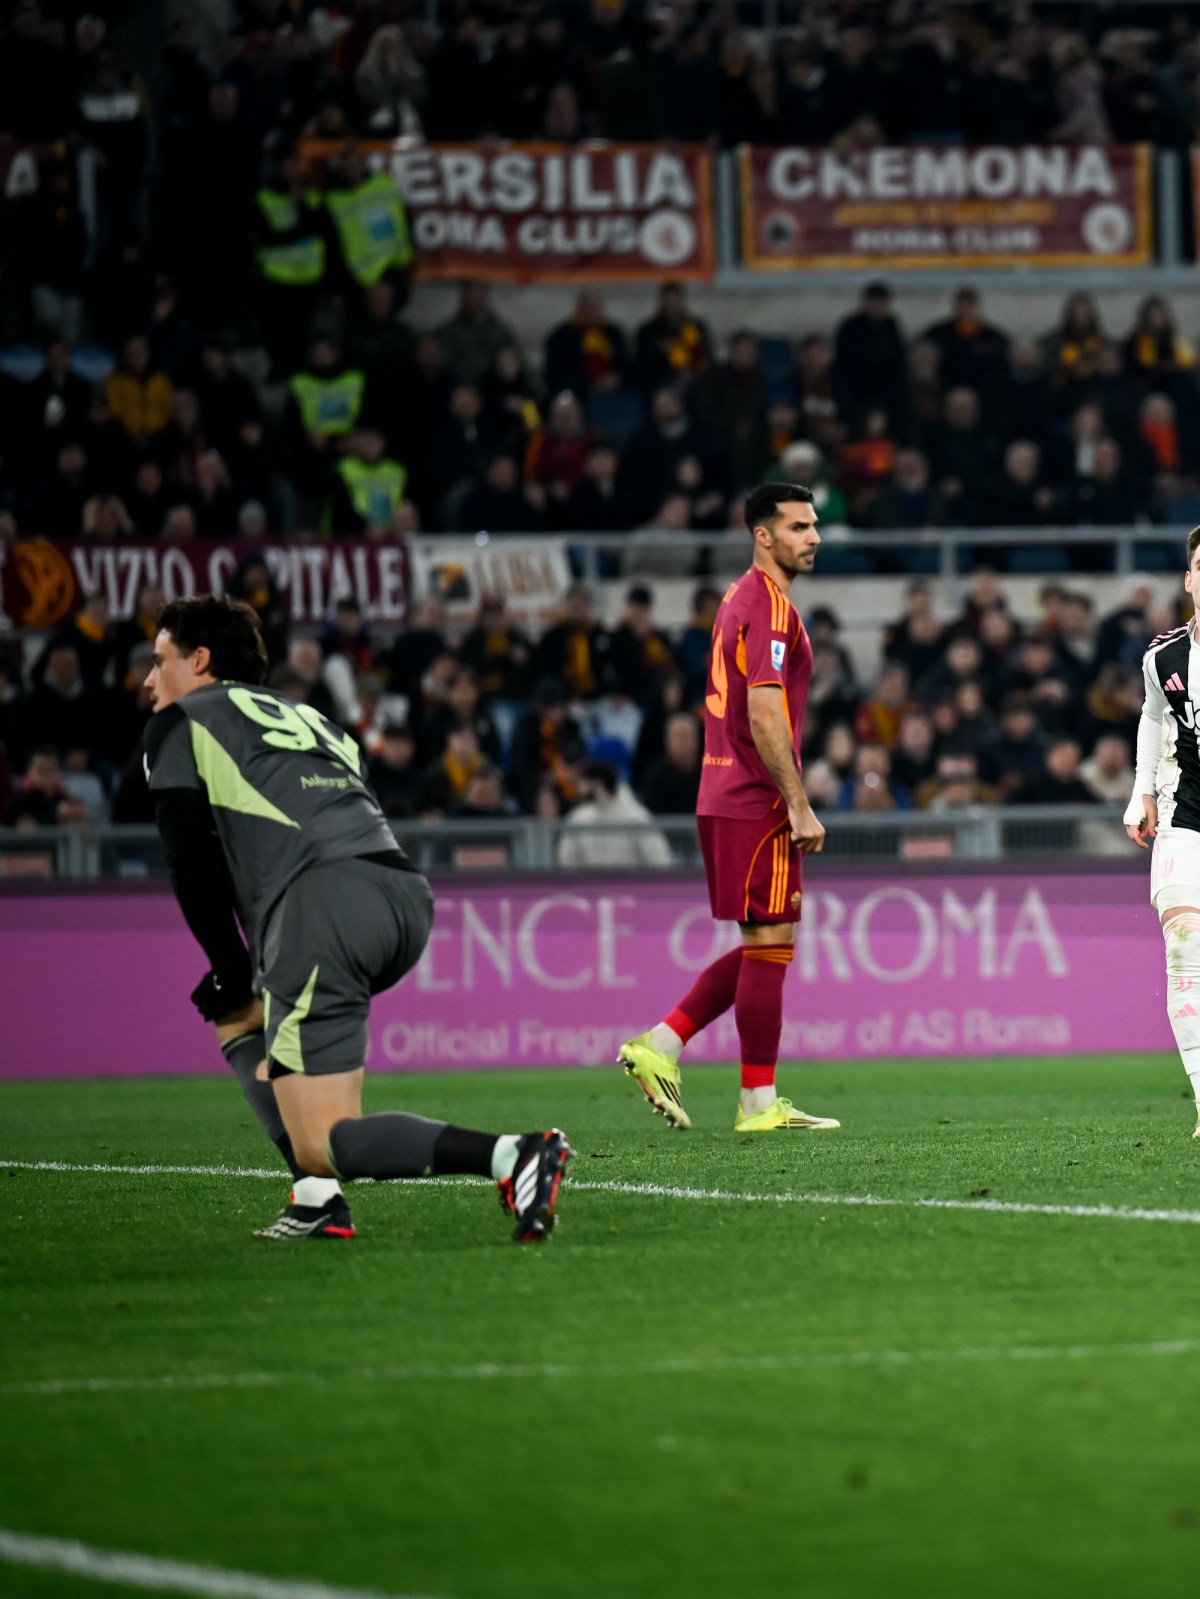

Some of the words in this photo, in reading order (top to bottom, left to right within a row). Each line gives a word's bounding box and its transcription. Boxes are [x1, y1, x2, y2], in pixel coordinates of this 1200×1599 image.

[370, 152, 696, 212] ERSILIA
[412, 210, 508, 252] OMA
[207, 545, 407, 620] CPITALE
[416, 896, 637, 992] ENCE
[799, 887, 1068, 983] ROMA
[381, 1018, 510, 1062] Official
[900, 1008, 957, 1049] AS
[963, 1007, 1069, 1049] Roma
